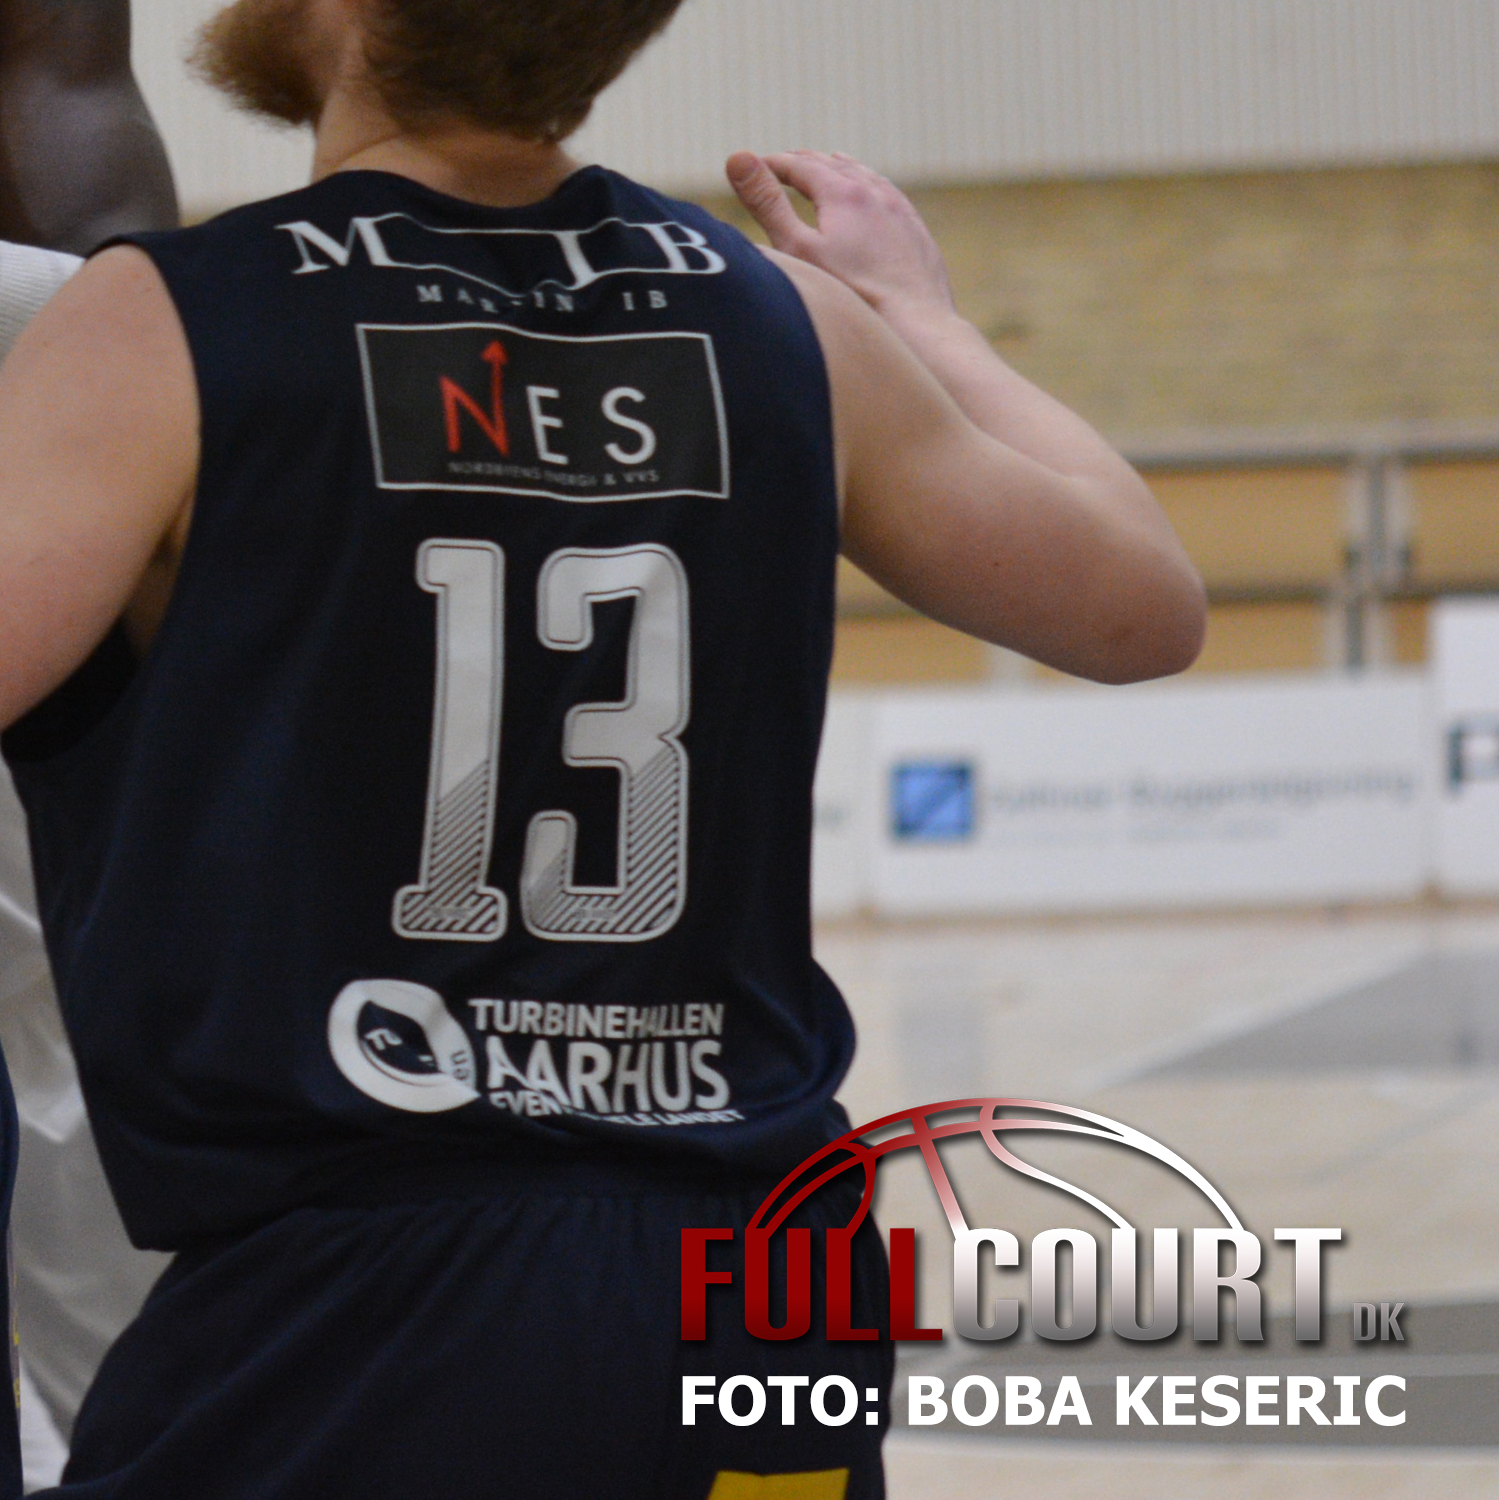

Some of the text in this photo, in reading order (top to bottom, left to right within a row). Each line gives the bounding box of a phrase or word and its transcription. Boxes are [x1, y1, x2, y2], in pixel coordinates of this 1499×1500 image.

[439, 339, 656, 466] NES
[391, 537, 691, 943] 13
[467, 998, 725, 1038] TURBINEHALLEN
[486, 1035, 731, 1114] AARHUS
